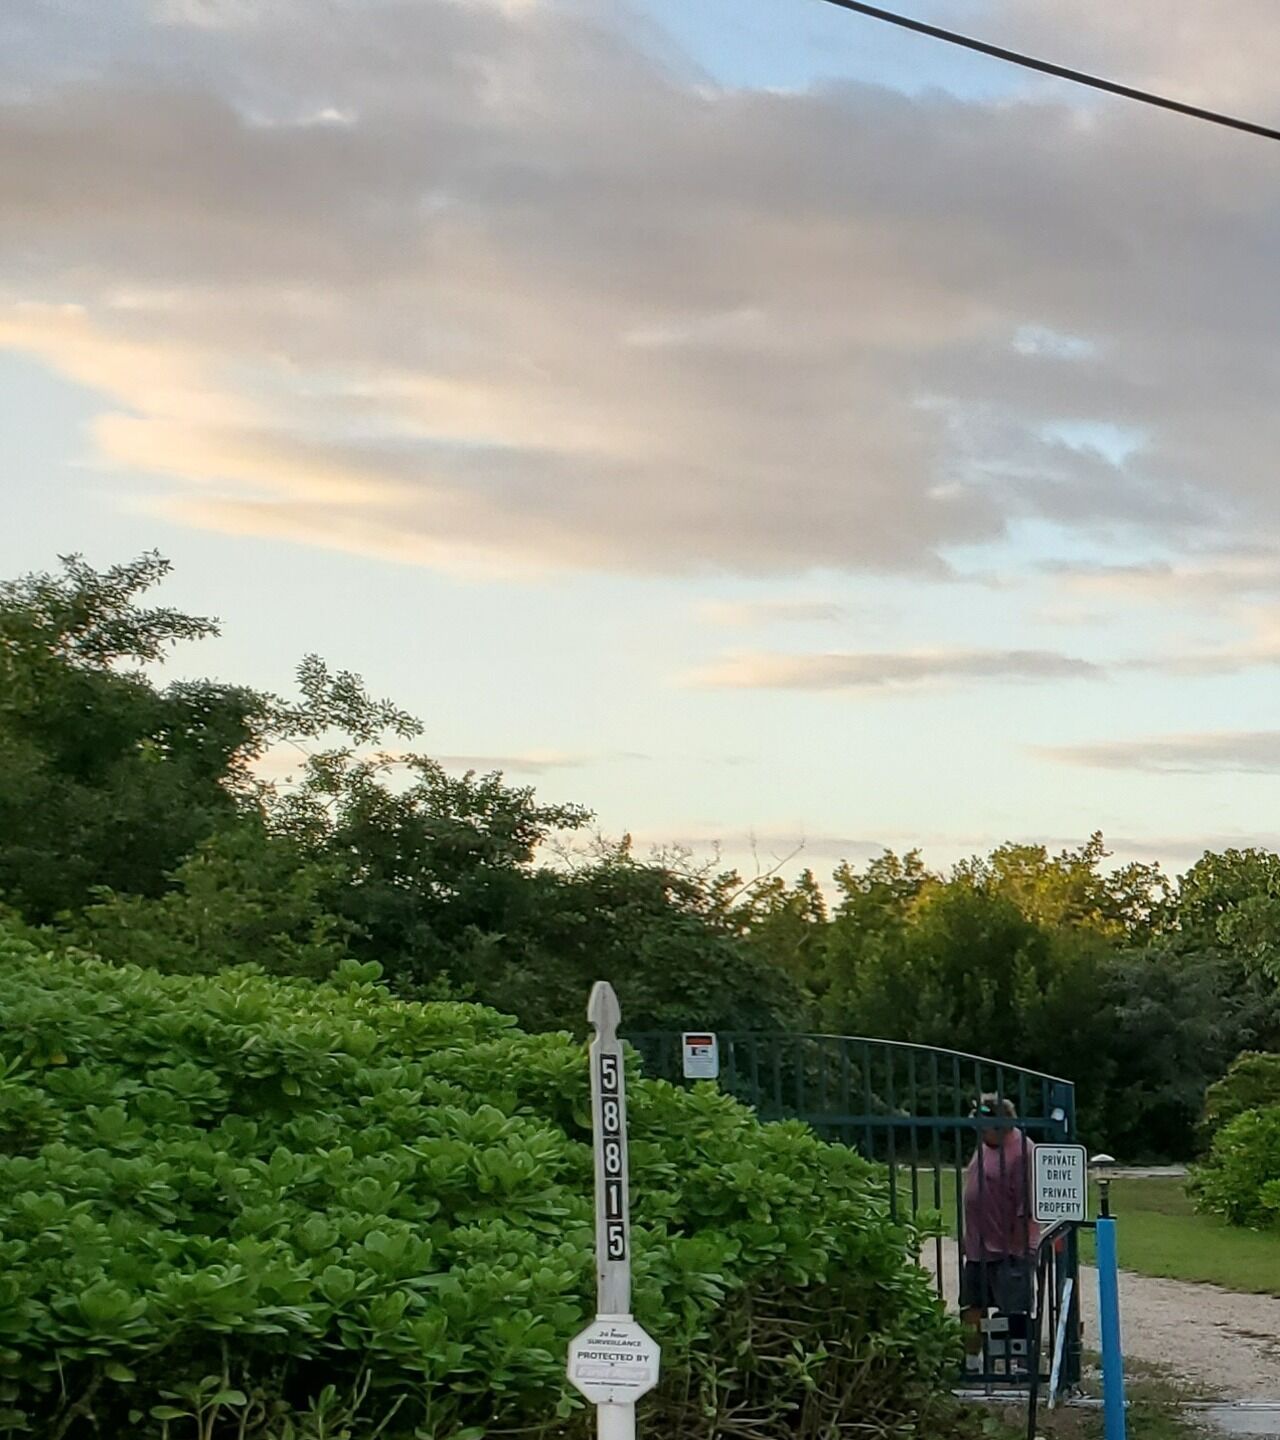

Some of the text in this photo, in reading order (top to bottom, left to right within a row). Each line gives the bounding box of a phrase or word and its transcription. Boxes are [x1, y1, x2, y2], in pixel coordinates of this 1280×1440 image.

[602, 1058, 623, 1257] 58815
[1042, 1155, 1077, 1166] PRIVATE
[1047, 1170, 1072, 1180] DRIVE
[1042, 1187, 1077, 1199] PRIVATE
[1039, 1201, 1080, 1213] PROPERTY
[577, 1352, 649, 1362] PROTECTED BY
